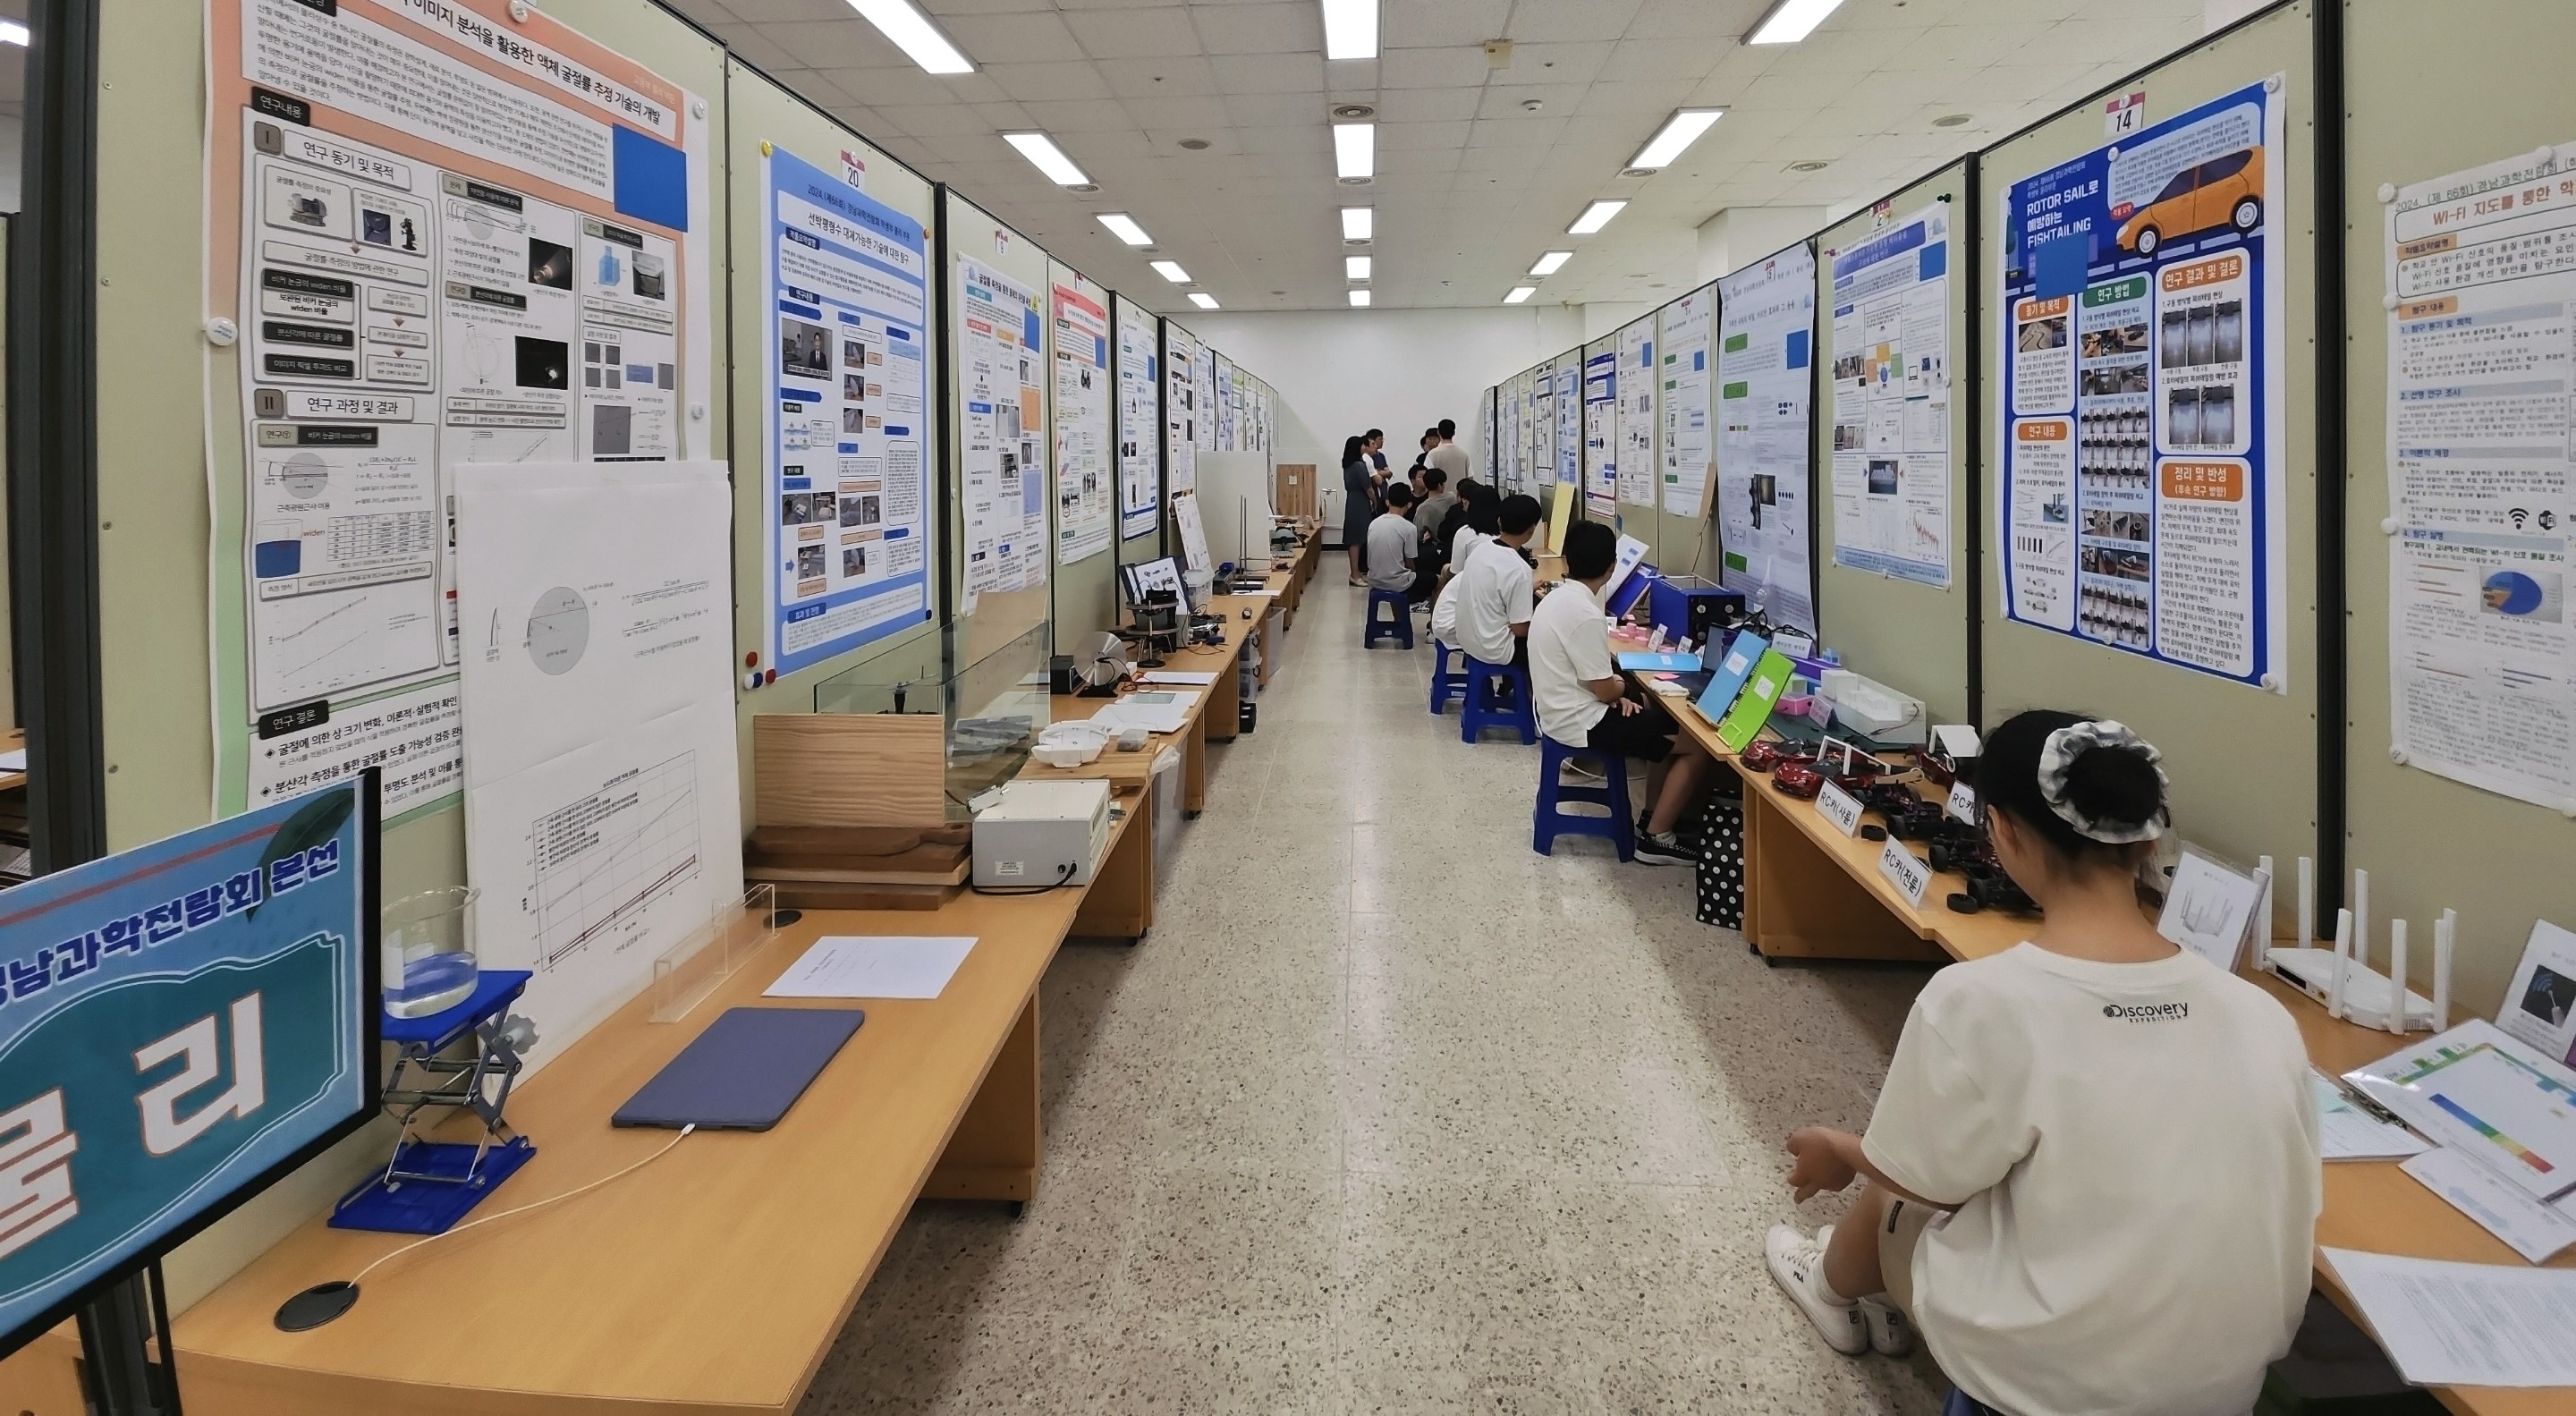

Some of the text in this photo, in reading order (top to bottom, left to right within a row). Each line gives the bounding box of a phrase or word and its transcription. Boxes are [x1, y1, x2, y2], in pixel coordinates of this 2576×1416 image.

[414, 0, 661, 124] 이미지 분석을 활용한 액체 굴절률 추정 기술의 개발
[260, 96, 301, 118] 연구내용
[2116, 110, 2131, 131] 14
[304, 142, 394, 181] 연구 동기 및 목적
[848, 167, 859, 188] 20
[2027, 180, 2098, 216] ROTOR SAIL로
[2474, 195, 2513, 216] 지도를
[2521, 185, 2551, 206] 통한
[2560, 180, 2576, 196] 학
[2028, 212, 2062, 233] 예방하는
[2028, 217, 2091, 249] FISHTAILING
[809, 212, 909, 265] 선박평형수 대체가능한 기술에 대한 탐구
[2165, 259, 2238, 288] 연구 결과 및 결론
[303, 297, 317, 305] 비커
[796, 289, 813, 301] 연구내용
[2097, 283, 2130, 302] 연구 방법
[2026, 306, 2038, 317] 동기
[2445, 386, 2461, 397] 조사
[308, 397, 398, 414] 연구 과정 및 결과
[2029, 425, 2055, 437] 연구 내용
[2174, 466, 2227, 483] 정리 및 반성
[2549, 554, 2564, 563] 조사
[273, 709, 316, 730] 연구 결론
[279, 737, 309, 756] 굴절에
[311, 732, 330, 745] 의한
[333, 728, 342, 740] 상
[344, 722, 361, 736] 크기
[364, 717, 385, 730] 변화,
[442, 696, 457, 708] 확인
[275, 775, 308, 794] 분산각
[310, 765, 340, 782] 측정을
[343, 759, 360, 773] 통한
[362, 750, 387, 767] 굴절률
[390, 744, 406, 757] 도출
[408, 735, 432, 750] 가능성
[435, 730, 449, 743] 검증
[384, 761, 453, 793] 투명도 분석 및 이를
[1818, 791, 1856, 828] RC카(사륜)
[1884, 848, 1922, 897] RC카(전륜)
[0, 838, 341, 1010] 남과학전람회 본선
[2110, 1003, 2188, 1017] Discovery
[1793, 1271, 1804, 1284] FILA
